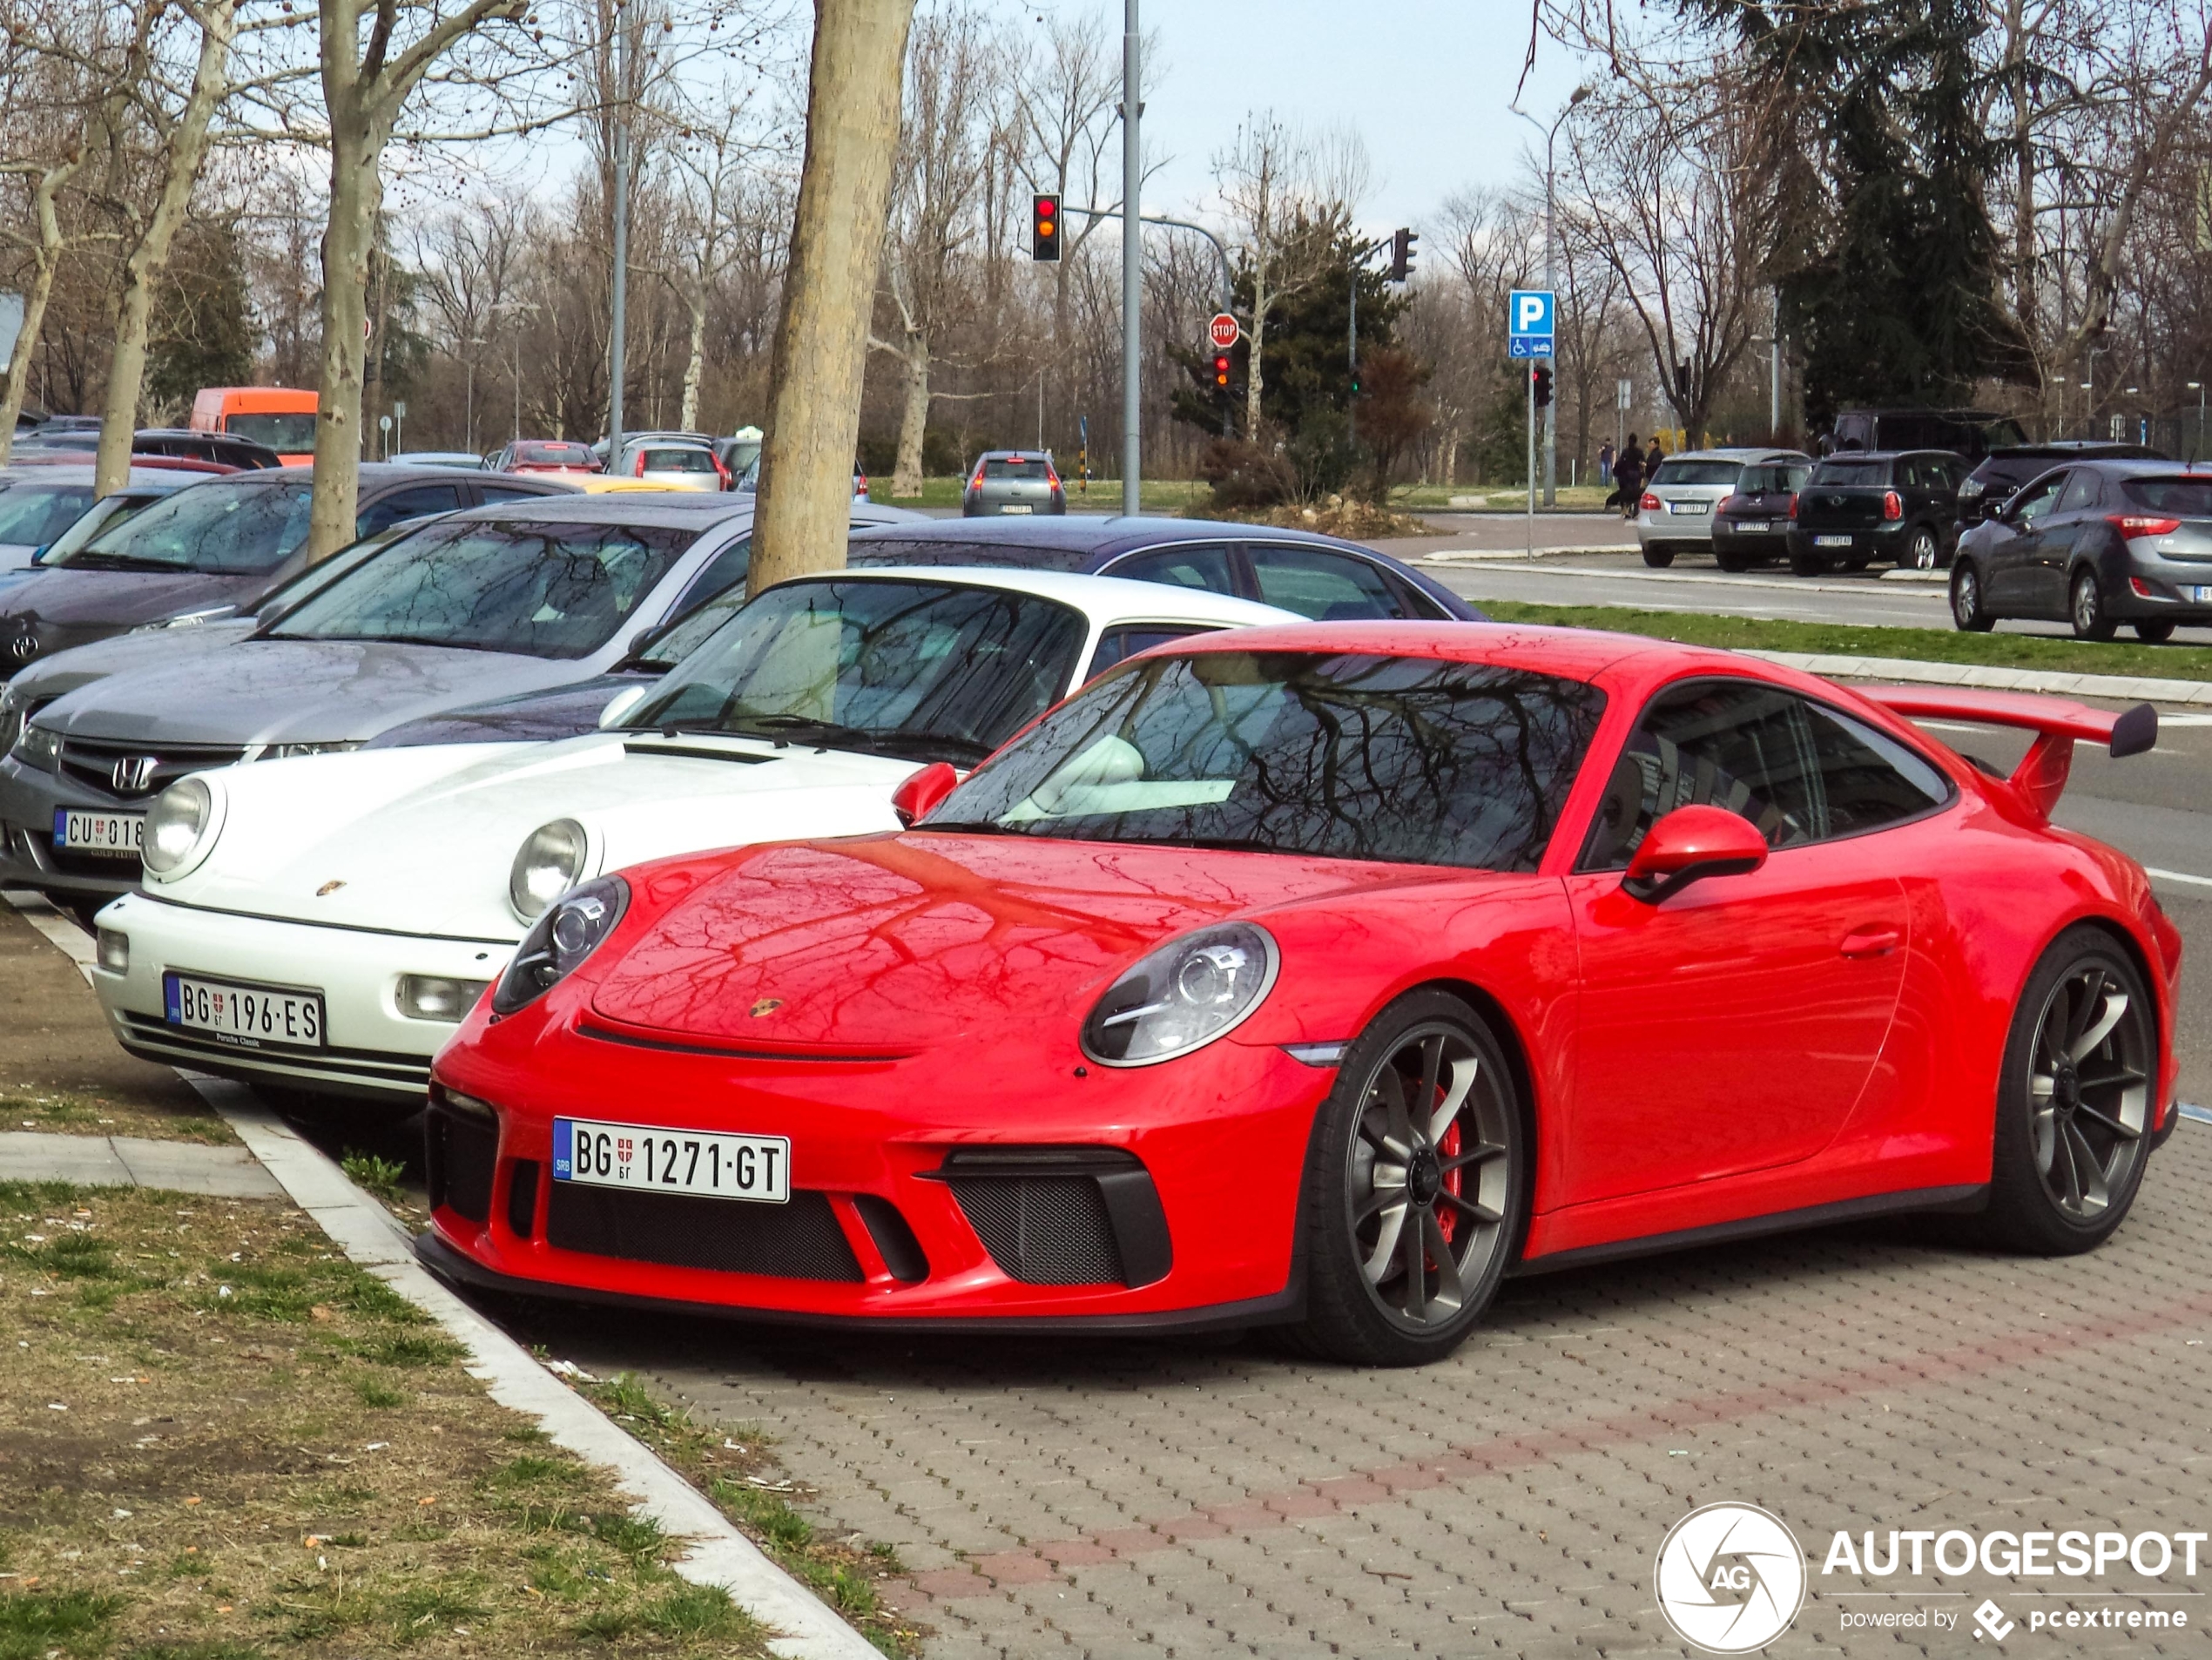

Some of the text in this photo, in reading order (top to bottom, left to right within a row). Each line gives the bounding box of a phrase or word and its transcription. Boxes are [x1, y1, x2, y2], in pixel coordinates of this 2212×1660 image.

[1520, 296, 1544, 331] P
[1212, 324, 1236, 337] STOP
[183, 984, 210, 1023] BG
[216, 1032, 260, 1048] Porsche Classic
[556, 1159, 570, 1172] SRB
[577, 1130, 611, 1177] BG
